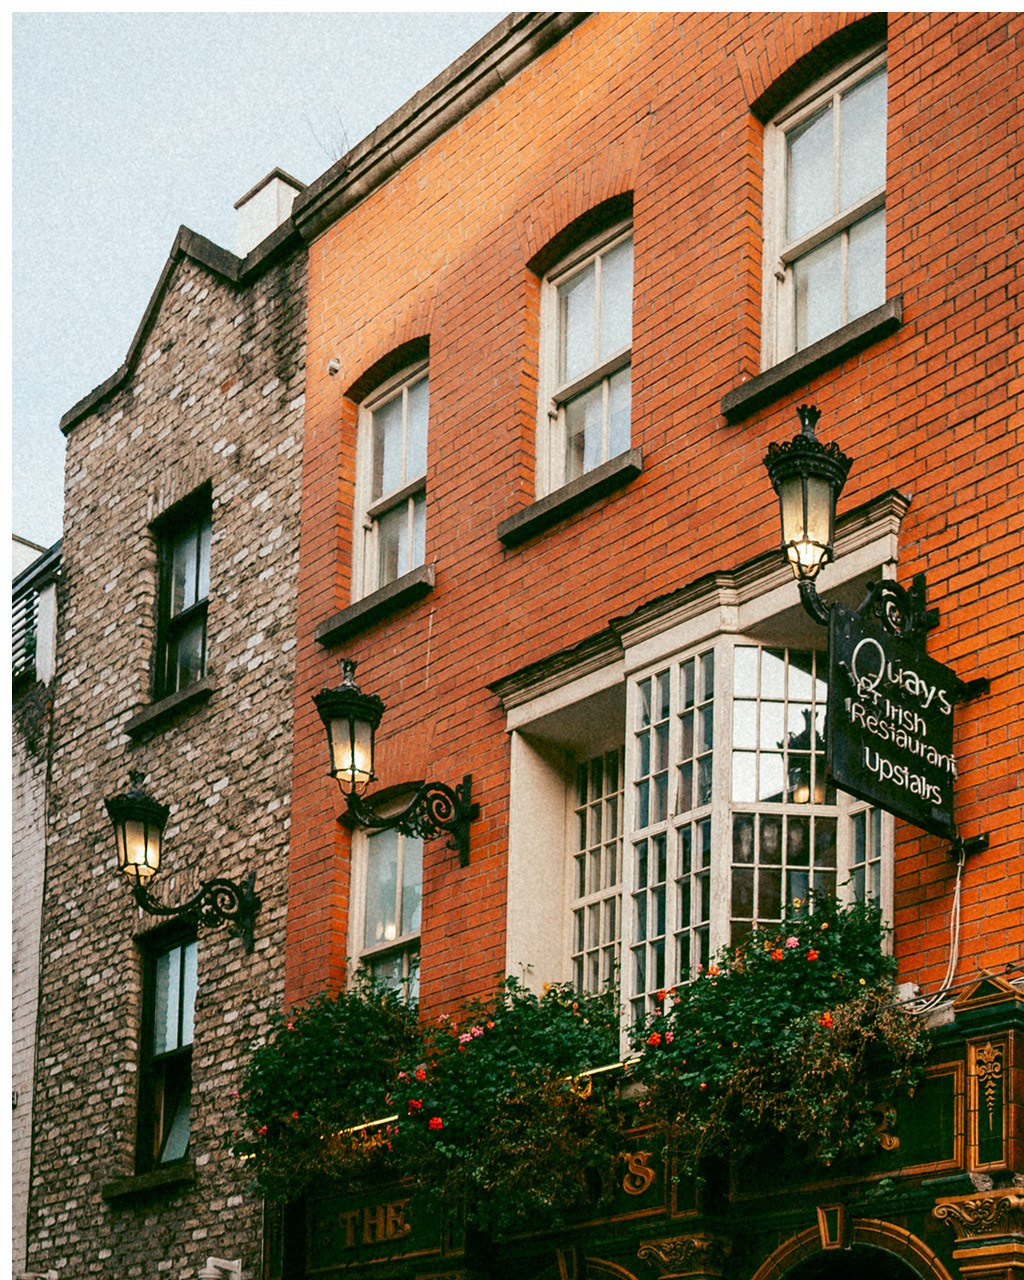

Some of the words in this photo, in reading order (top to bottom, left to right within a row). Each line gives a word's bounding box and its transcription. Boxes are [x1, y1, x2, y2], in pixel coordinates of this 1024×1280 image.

[852, 638, 952, 715] Quays
[885, 699, 927, 736] Irish
[865, 746, 942, 805] Upstairs
[338, 1198, 411, 1248] THE
